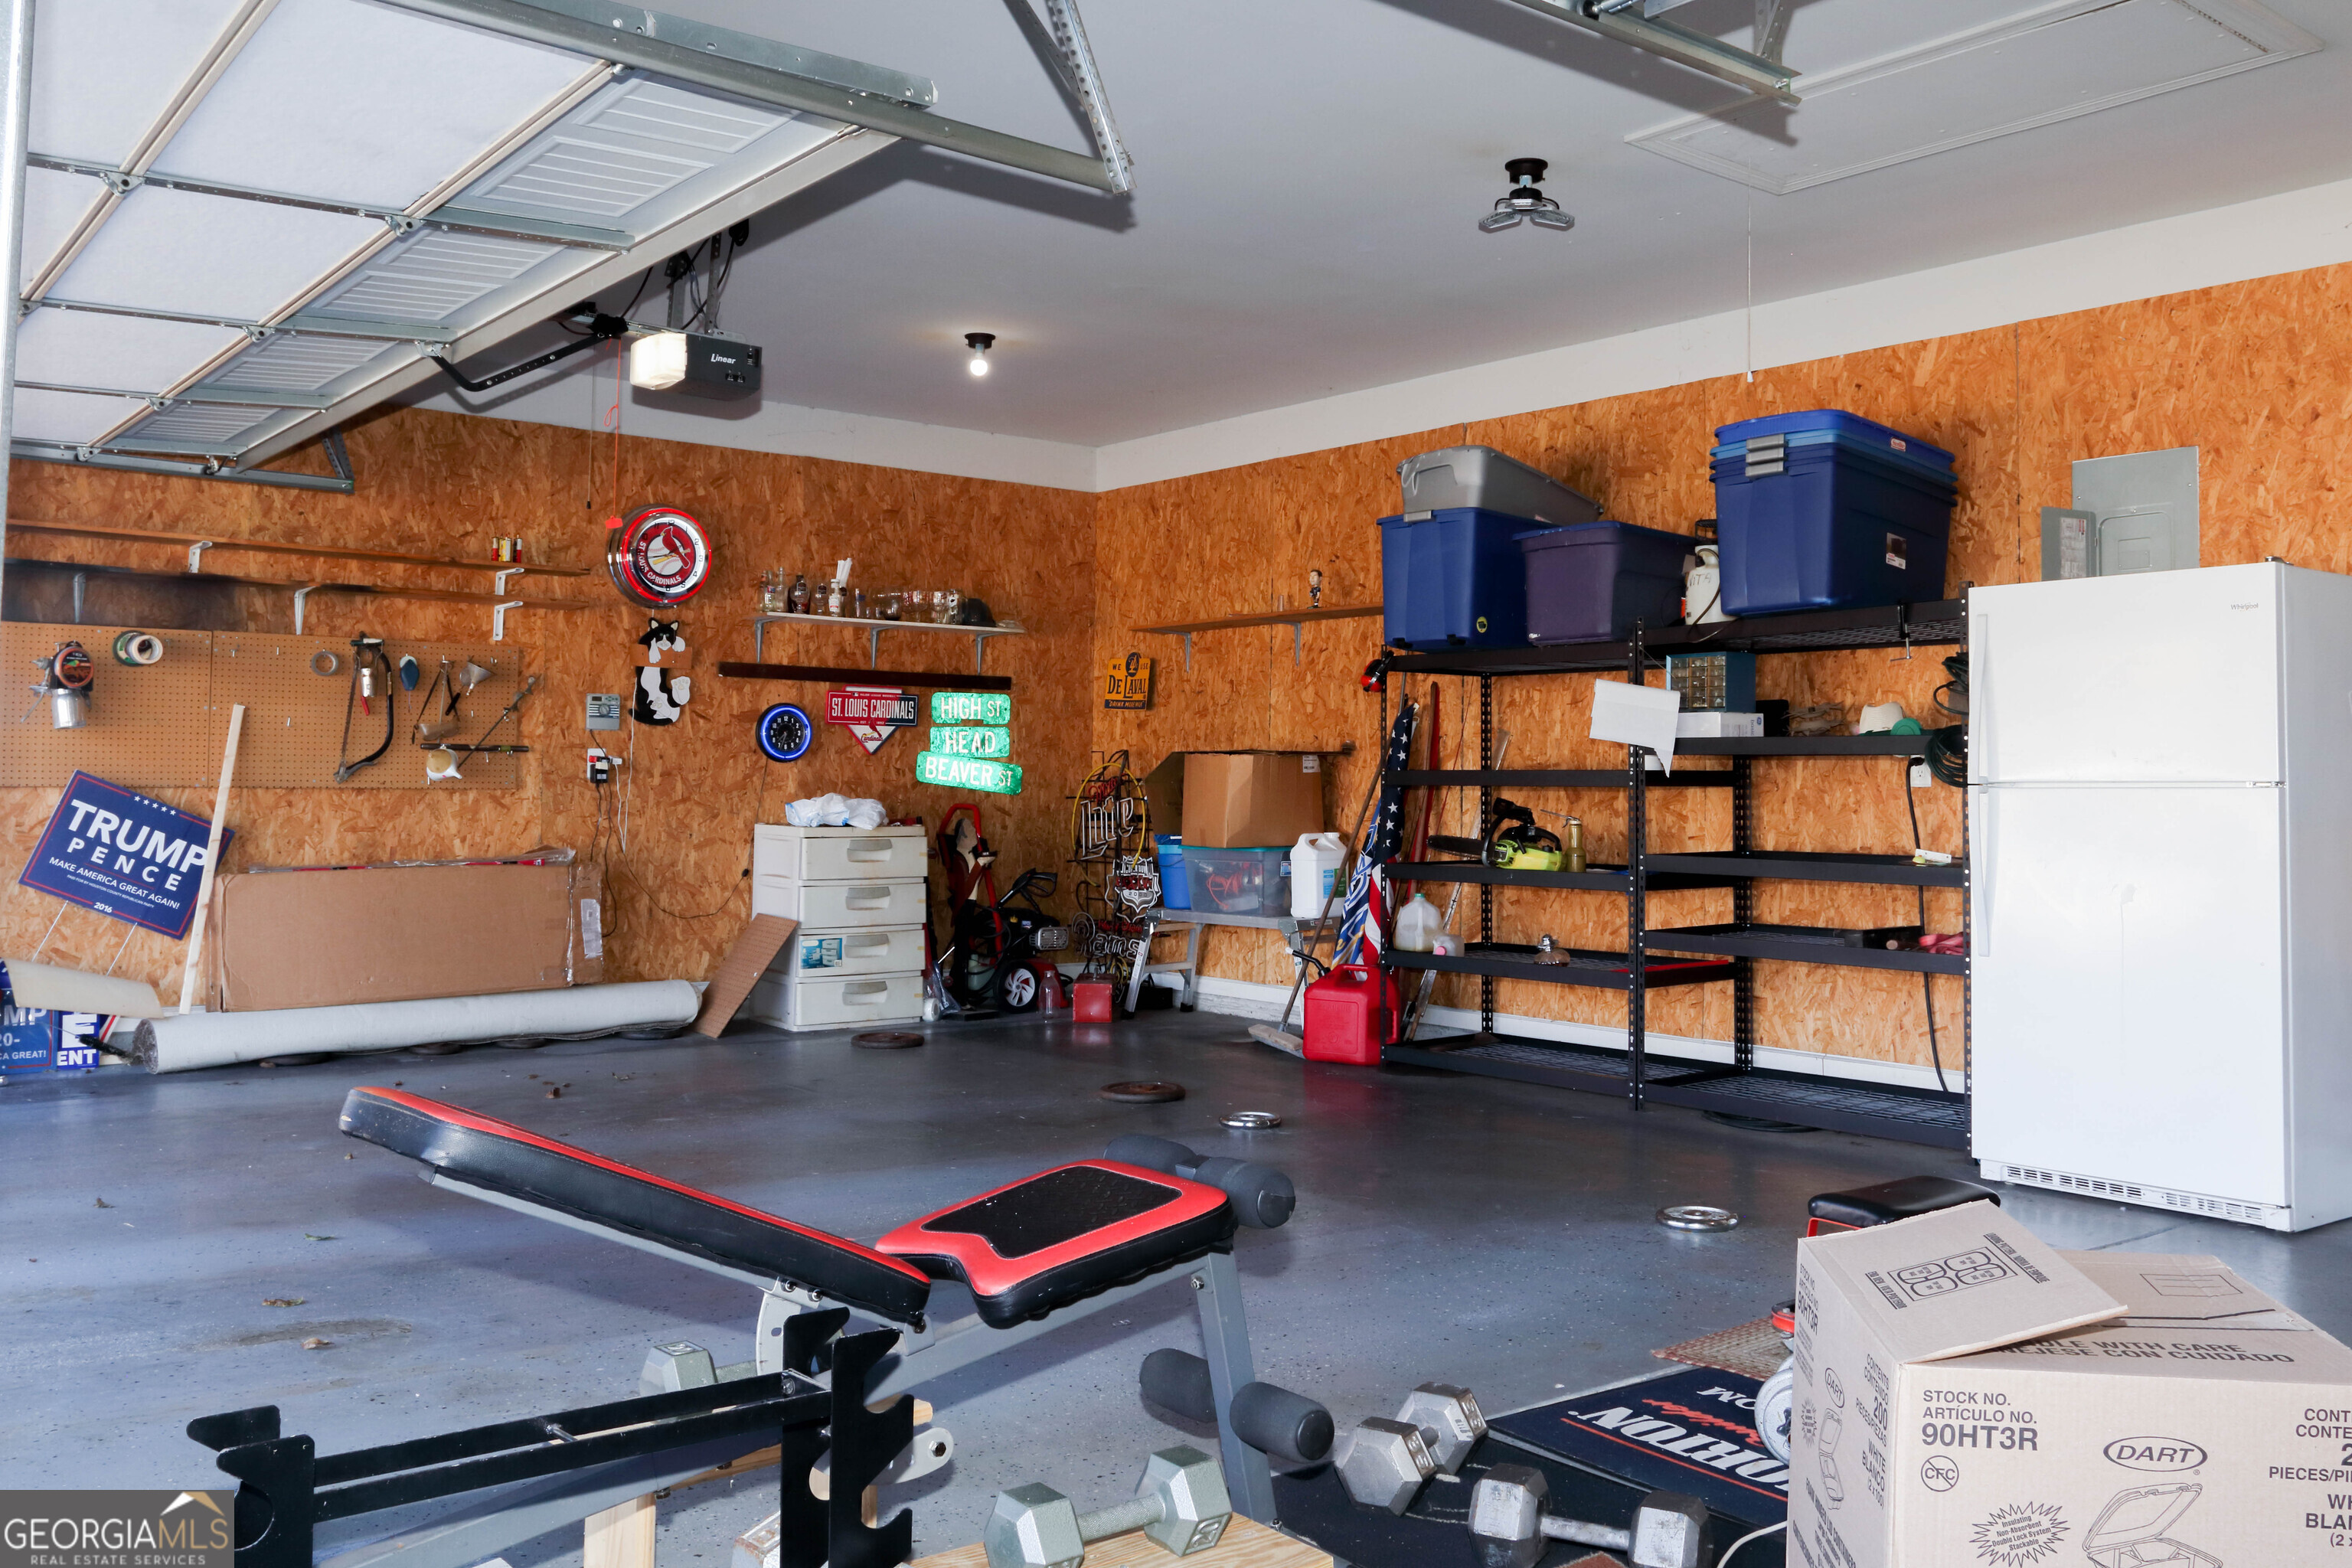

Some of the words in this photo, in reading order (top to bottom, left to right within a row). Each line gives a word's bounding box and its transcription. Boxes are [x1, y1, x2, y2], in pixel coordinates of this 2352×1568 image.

[710, 353, 736, 364] Linear
[647, 572, 681, 585] CARDINALS
[2230, 603, 2259, 611] Whirlpool
[831, 697, 843, 717] ST.
[844, 698, 868, 717] LOUIS
[871, 699, 914, 719] CARDINALS
[941, 697, 982, 719] HIGH
[987, 701, 1001, 717] ST
[945, 731, 996, 753] HEAD
[925, 756, 993, 786] BEAVER
[998, 770, 1013, 786] ST
[68, 799, 208, 873] TRUMP
[1080, 795, 1134, 861] Lite
[67, 838, 181, 891] PENCE
[49, 857, 77, 872] MAKE
[77, 867, 117, 887] AMERICA
[119, 882, 148, 897] GREAT
[148, 893, 181, 910] AGAIN!
[93, 902, 113, 913] 2016
[11, 1050, 46, 1060] GREAT!
[2092, 1341, 2164, 1351] WITH
[2171, 1343, 2247, 1353] CARE
[2102, 1350, 2162, 1359] CON
[2168, 1351, 2295, 1363] CUIDADO
[1867, 1354, 1890, 1390] CONTENTS
[1827, 1373, 1843, 1401] DART
[1864, 1366, 1889, 1406] CONTENIDO
[1922, 1390, 1978, 1404] STOCK
[1984, 1393, 2011, 1406] NO.
[1873, 1396, 1888, 1431] 200
[1922, 1405, 2004, 1422] ARTÍCULO
[2010, 1411, 2037, 1424] NO.
[2305, 1408, 2352, 1423] CONT
[1922, 1423, 2038, 1451] 90HT3R
[1577, 1406, 1789, 1491] ORTON
[1868, 1438, 1886, 1473] WHITE
[2116, 1445, 2195, 1464] DART
[1862, 1451, 1886, 1492] BLANCO
[2269, 1466, 2352, 1483] PIECES/PI
[1996, 1521, 2042, 1537] Non-Absorbent
[2001, 1516, 2032, 1527] Insulating
[1992, 1537, 2013, 1547] Double
[2013, 1533, 2028, 1541] Lock
[2028, 1527, 2052, 1538] System
[2009, 1538, 2040, 1551] Stackable
[2330, 1532, 2344, 1547] (2
